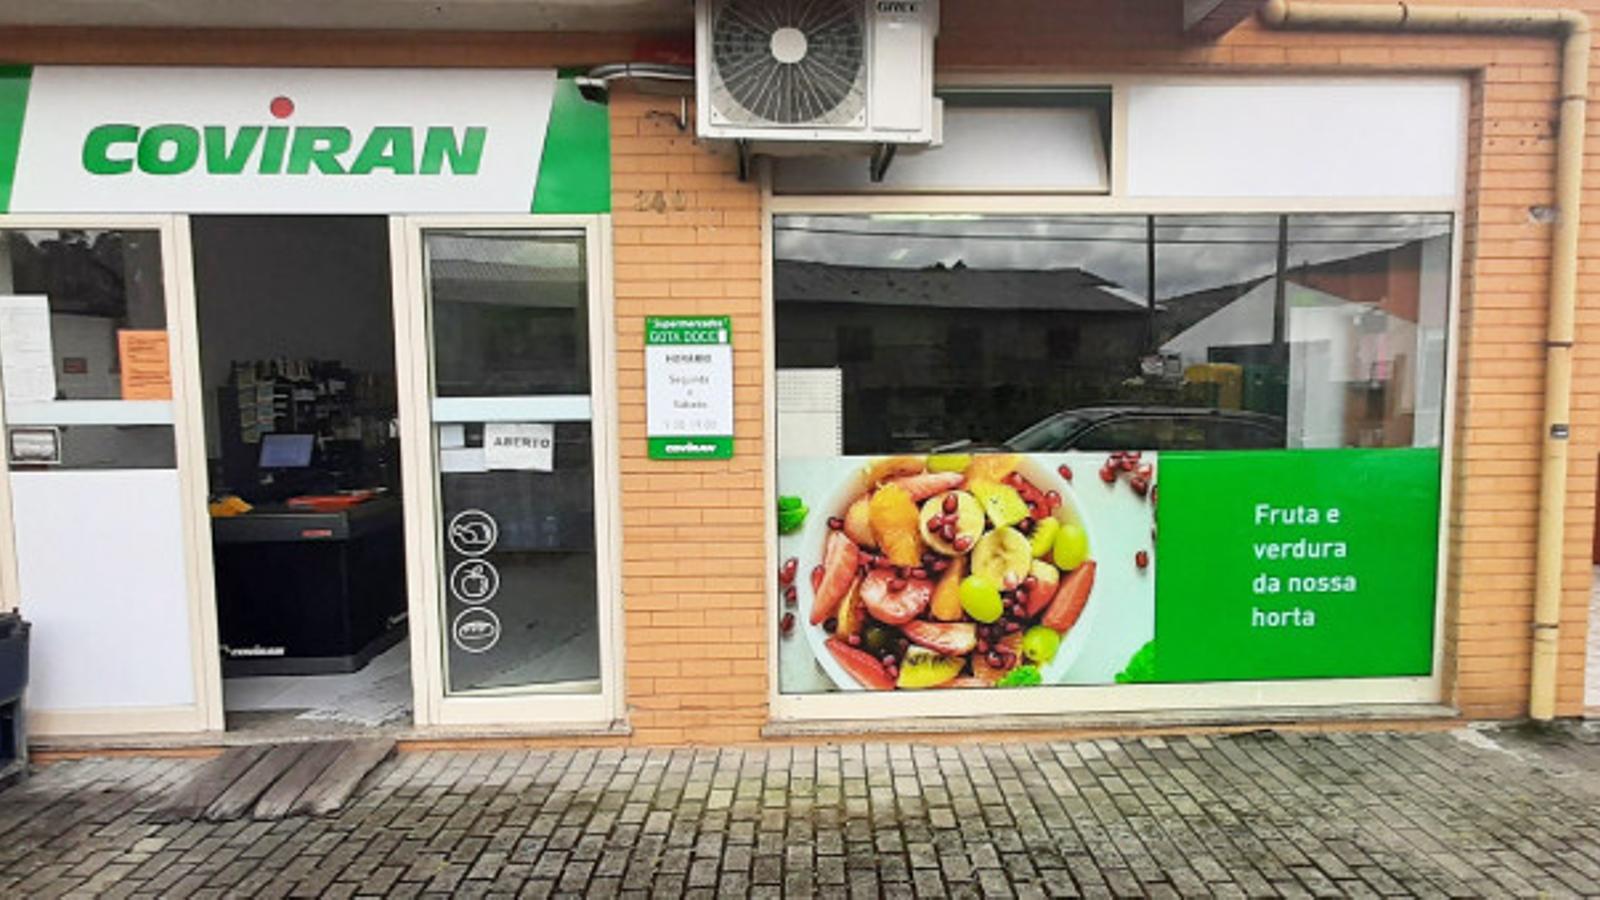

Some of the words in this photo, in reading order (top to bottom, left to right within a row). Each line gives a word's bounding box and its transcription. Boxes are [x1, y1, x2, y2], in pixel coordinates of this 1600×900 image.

[82, 97, 486, 176] COVIRAN
[1254, 503, 1320, 525] Fruta
[1326, 507, 1340, 524] e
[1252, 538, 1347, 560] verdura
[1252, 573, 1281, 594] da
[1288, 575, 1357, 593] nossa
[1251, 606, 1316, 627] horta
